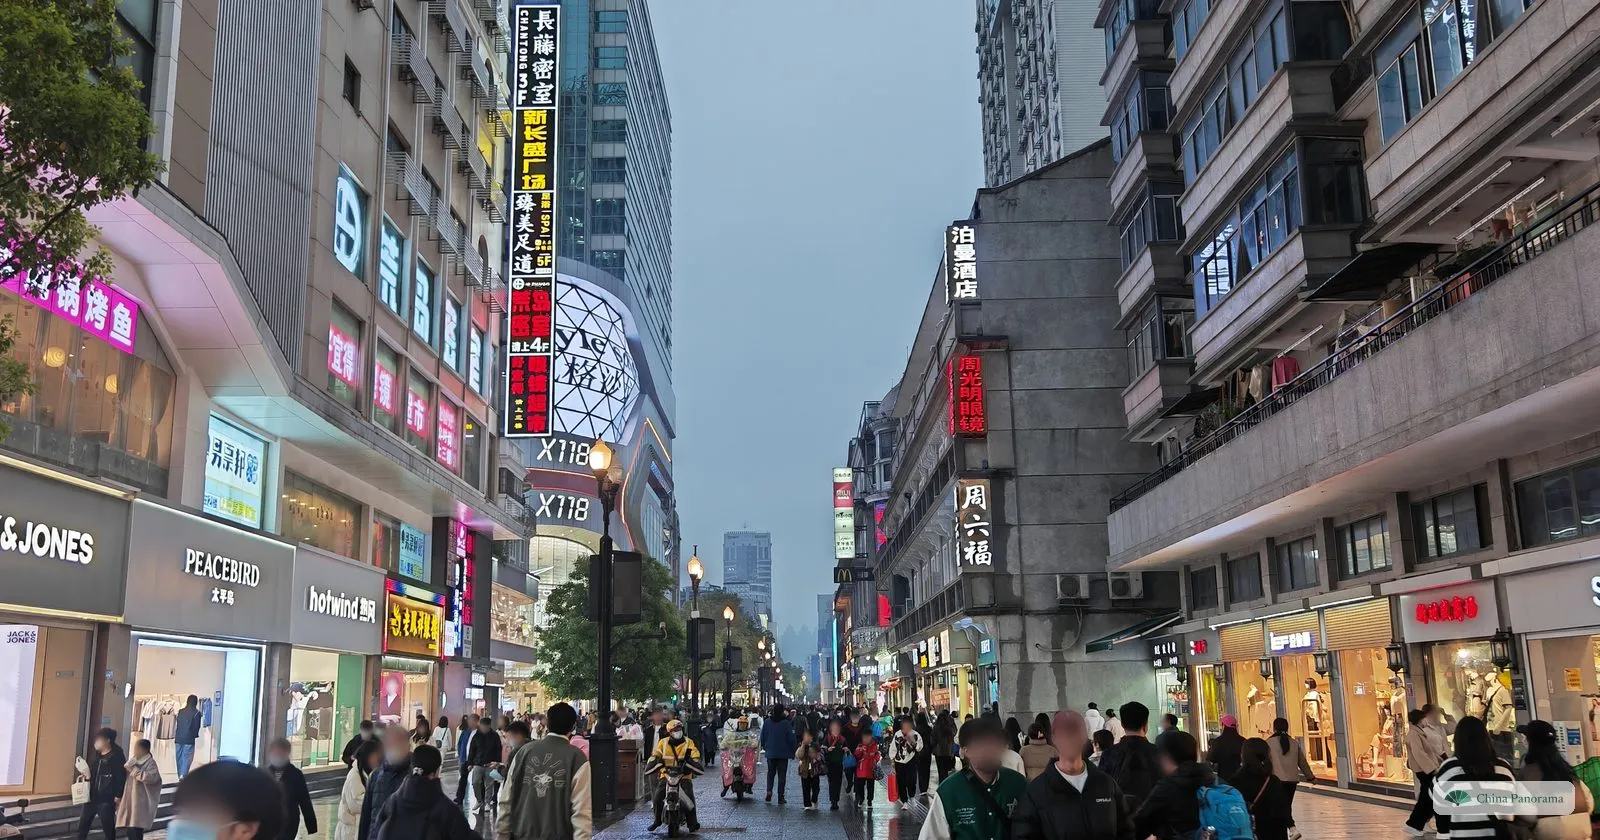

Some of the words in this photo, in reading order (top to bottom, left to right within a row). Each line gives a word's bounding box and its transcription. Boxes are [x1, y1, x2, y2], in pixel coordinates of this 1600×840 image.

[519, 10, 528, 70] CHANTONG
[532, 10, 555, 105] 長藤密室
[517, 73, 528, 105] 3F
[521, 110, 548, 190] 新长盛广场
[513, 192, 537, 274] 臻美足道
[541, 214, 551, 233] SPA
[536, 256, 552, 267] 5F
[951, 225, 978, 298] 泊曼酒店
[959, 356, 985, 432] 周光明眼镜
[537, 438, 591, 467] X118
[535, 492, 589, 521] X118
[961, 485, 992, 566] 周六福
[0, 515, 94, 564] &JONES
[184, 547, 260, 588] PEACEBIRD
[309, 585, 359, 620] hotwind
[359, 597, 376, 624] 热风
[6, 636, 36, 644] JONES
[7, 630, 36, 638] JACK&
